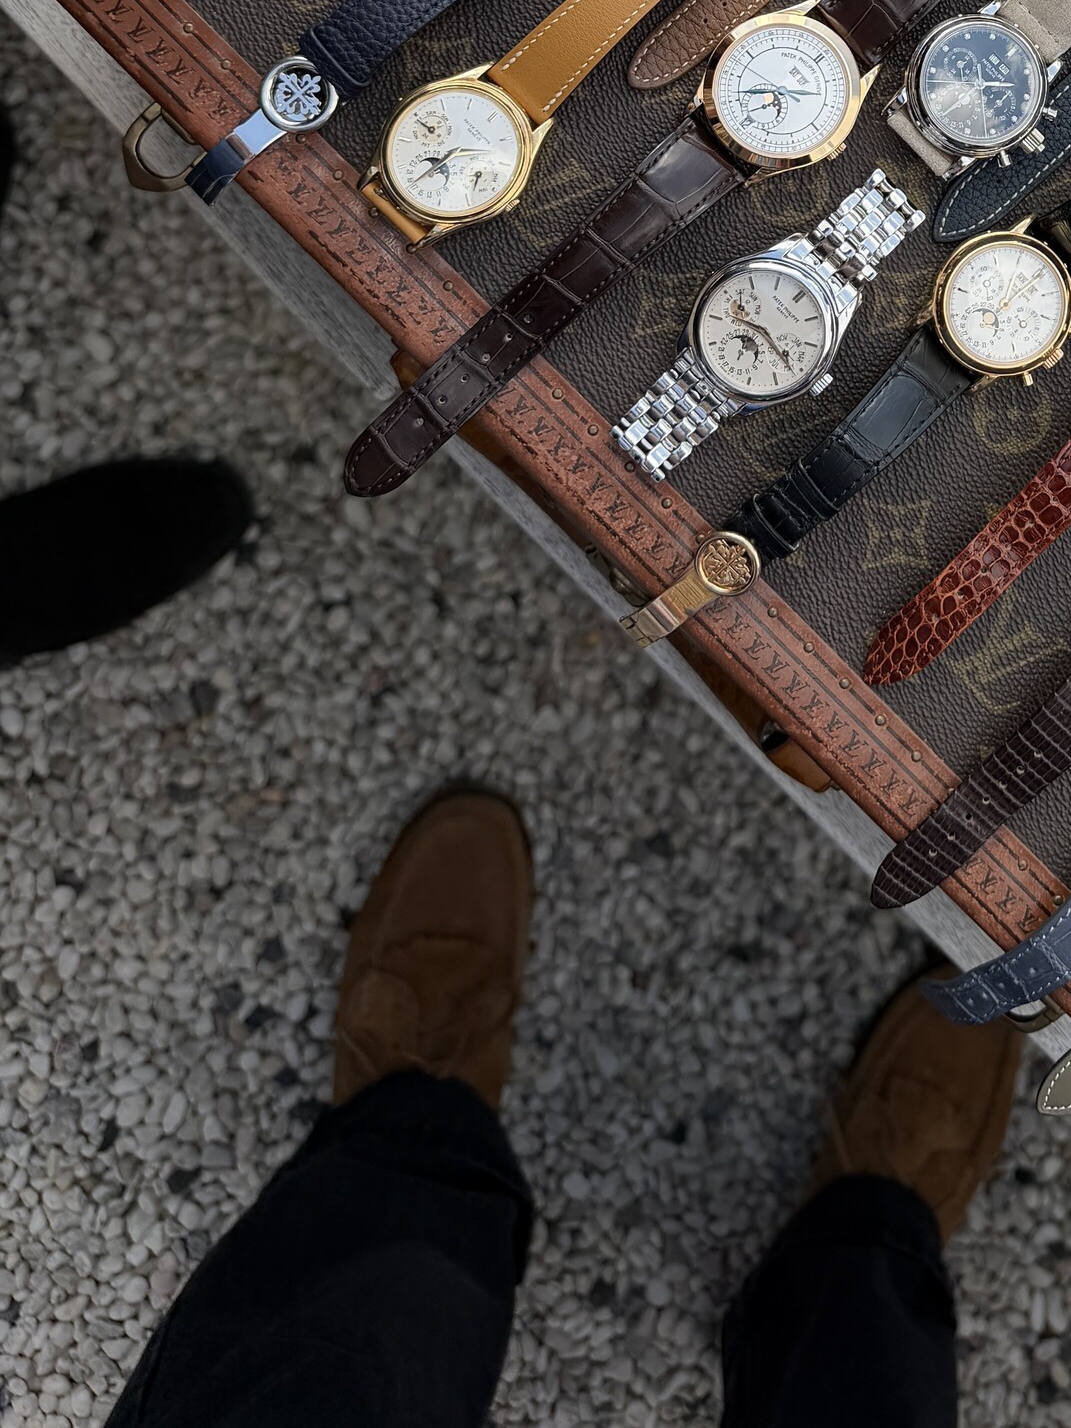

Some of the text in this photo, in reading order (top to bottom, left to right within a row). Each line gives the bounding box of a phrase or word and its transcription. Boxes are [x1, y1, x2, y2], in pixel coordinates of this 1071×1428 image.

[781, 52, 797, 60] PATEK
[798, 57, 815, 75] PHILIPPE
[980, 57, 1005, 82] PATEK PHILIPPE
[462, 117, 492, 146] PATEK PHILIPPE
[739, 117, 750, 130] 12
[770, 294, 800, 324] PATEK PHILIPPE
[775, 305, 789, 319] GENEVE
